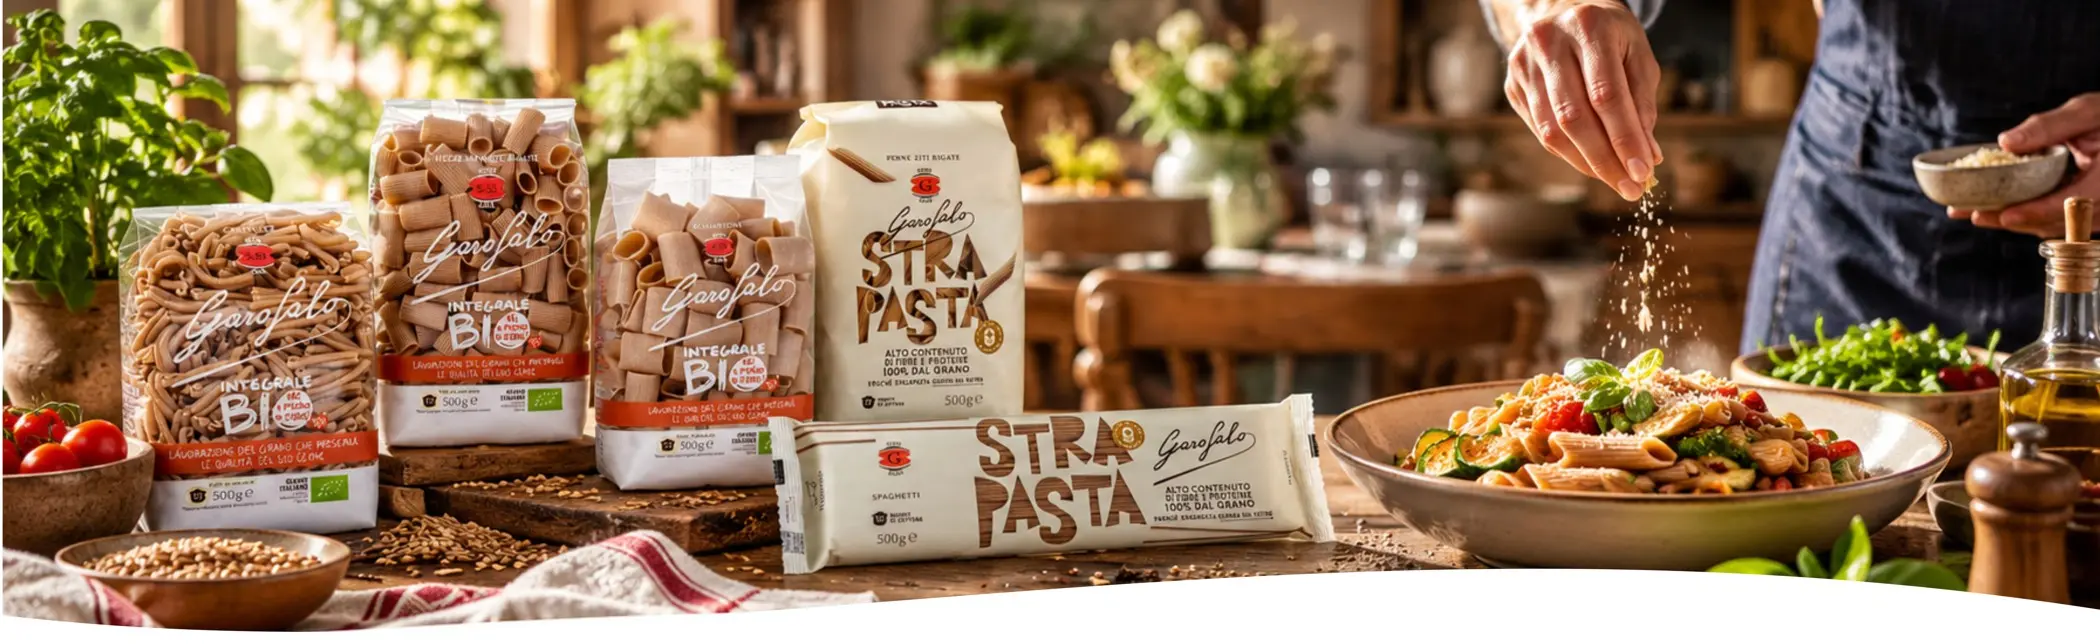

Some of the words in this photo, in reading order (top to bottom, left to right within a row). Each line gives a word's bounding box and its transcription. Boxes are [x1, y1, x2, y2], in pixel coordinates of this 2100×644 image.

[919, 179, 932, 192] G
[881, 199, 968, 245] Garofalo
[413, 211, 556, 285] Garofalo
[861, 230, 988, 289] STRA
[652, 262, 788, 332] Garofalo
[173, 276, 339, 364] Garofalo
[856, 285, 990, 345] PASTA
[683, 343, 766, 358] INTEGRALE
[885, 349, 909, 358] ALTO
[911, 347, 968, 357] CONTENUTO
[911, 367, 931, 376] DAL
[220, 375, 314, 392] INTEGRALE
[442, 397, 469, 408] 500g
[944, 395, 974, 408] 500g
[680, 440, 705, 452] 500g
[975, 415, 1134, 478] STRA
[1153, 420, 1248, 471] Garofalo
[887, 451, 902, 465] G
[1165, 485, 1189, 494] ALTO
[1191, 482, 1251, 493] CONTENUTO
[212, 490, 243, 503] 500g
[872, 492, 921, 501] SPAGHETTI
[974, 468, 1147, 549] PASTA
[1165, 502, 1191, 512] 100%
[1194, 501, 1214, 510] DAL
[876, 533, 907, 548] 500g
